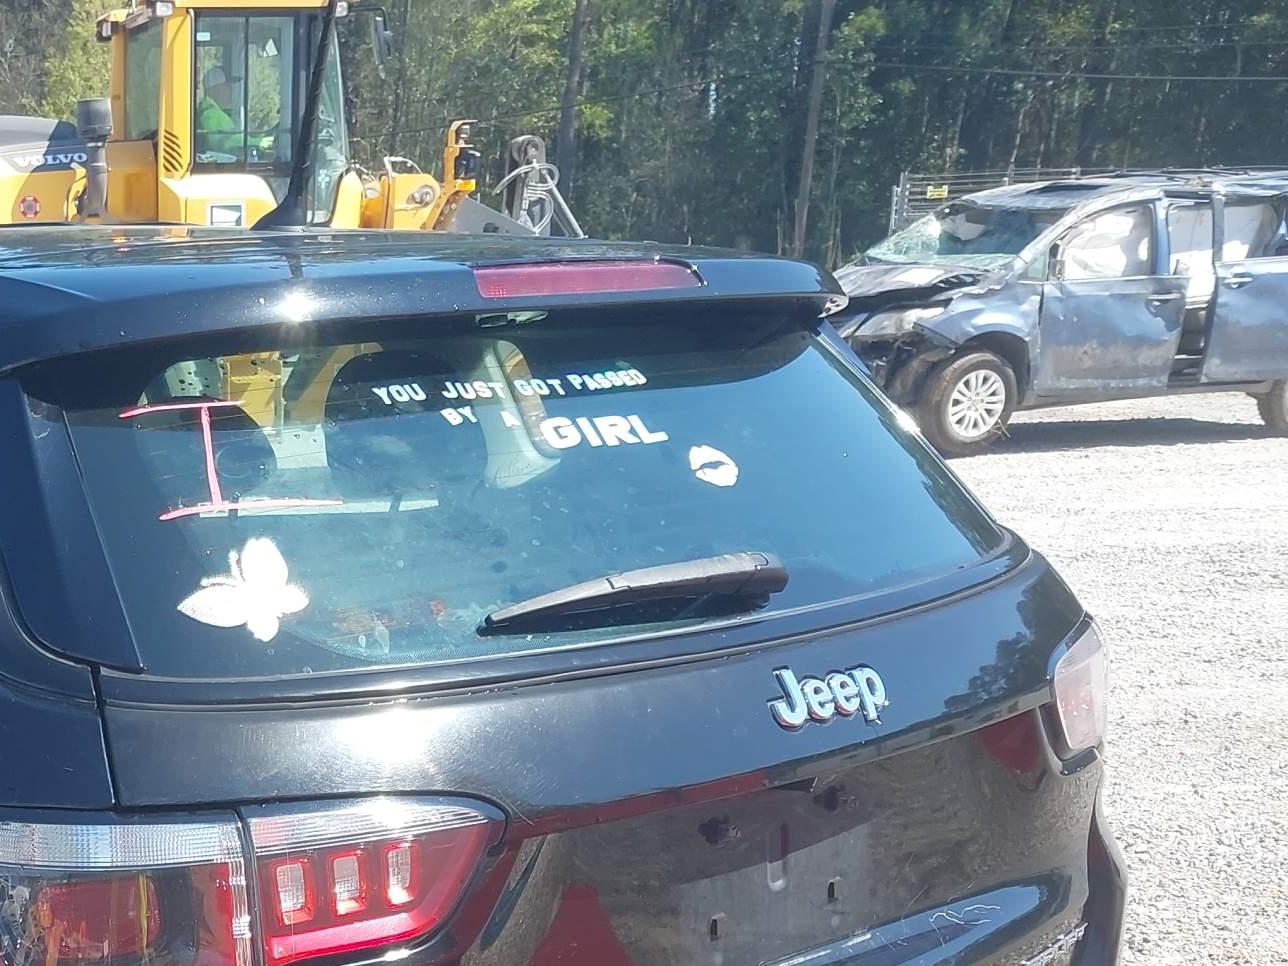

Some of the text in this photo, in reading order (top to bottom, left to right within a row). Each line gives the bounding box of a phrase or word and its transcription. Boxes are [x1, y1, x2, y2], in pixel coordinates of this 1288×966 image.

[13, 153, 88, 169] VOLVO
[372, 368, 648, 405] YOU JUST GOT PASSED
[440, 405, 670, 449] BY A GIRL
[766, 665, 888, 728] Jeep
